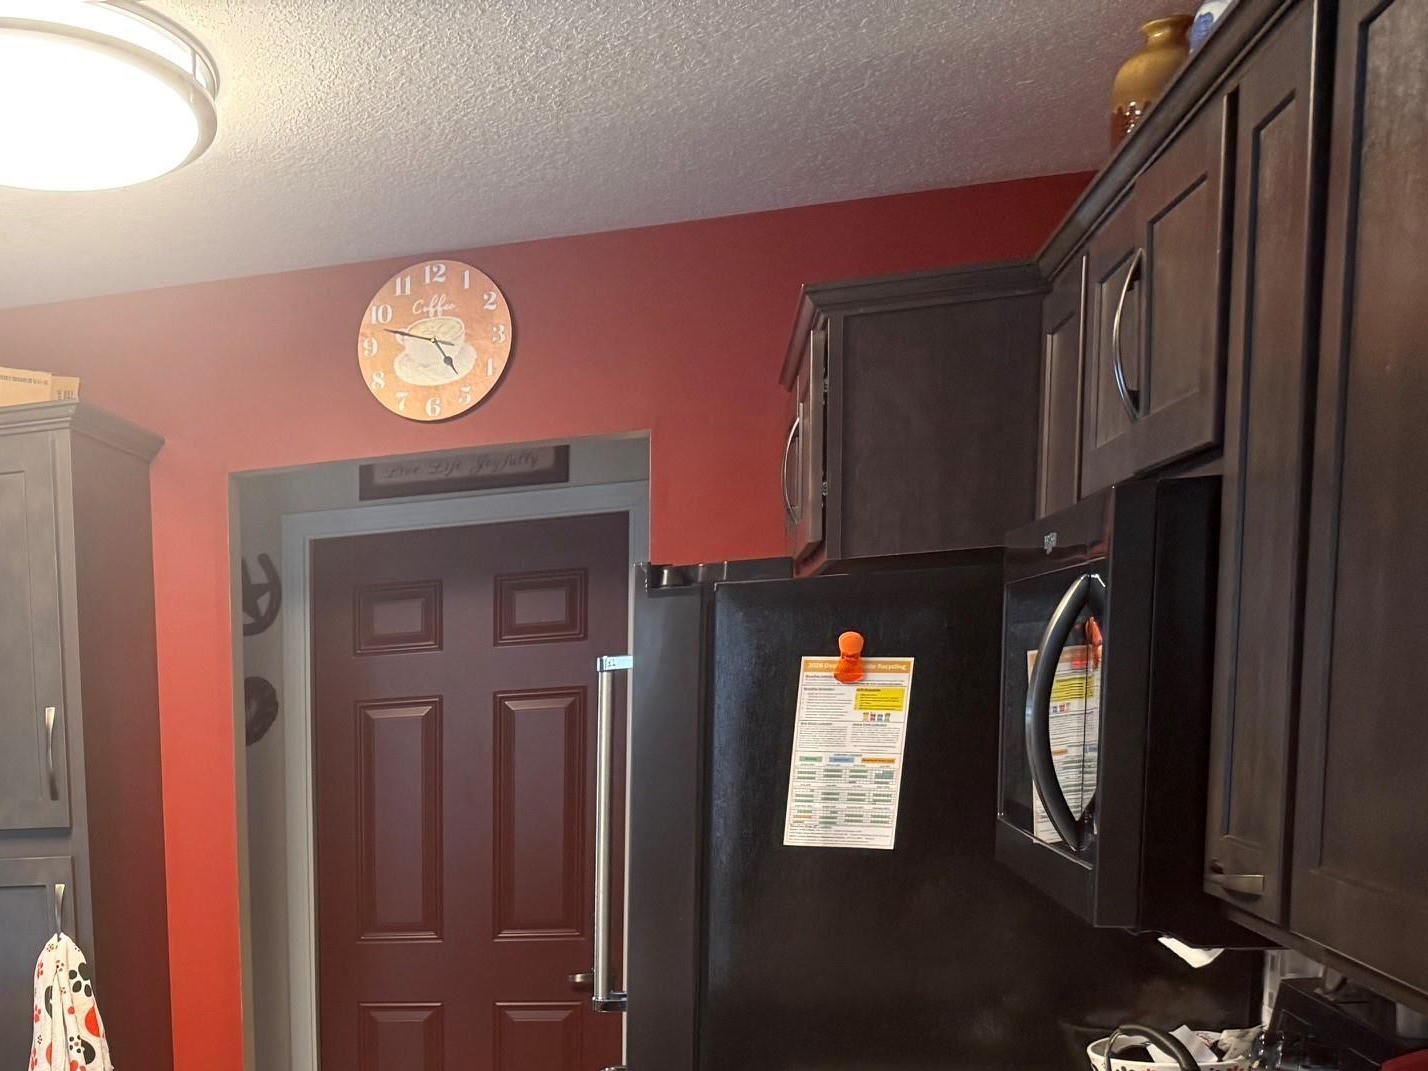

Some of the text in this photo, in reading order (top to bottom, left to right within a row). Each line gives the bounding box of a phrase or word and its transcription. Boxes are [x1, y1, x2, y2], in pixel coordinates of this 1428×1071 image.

[424, 263, 446, 284] 12
[463, 270, 470, 289] 1
[395, 275, 411, 296] 11
[412, 293, 457, 316] Coffee
[483, 291, 497, 311] 2
[372, 304, 393, 325] 10
[492, 324, 506, 344] 3
[363, 338, 378, 357] 9
[371, 371, 386, 391] 8
[395, 392, 408, 411] 7
[458, 386, 473, 405] 5
[425, 397, 441, 417] 6
[427, 458, 462, 477] Life
